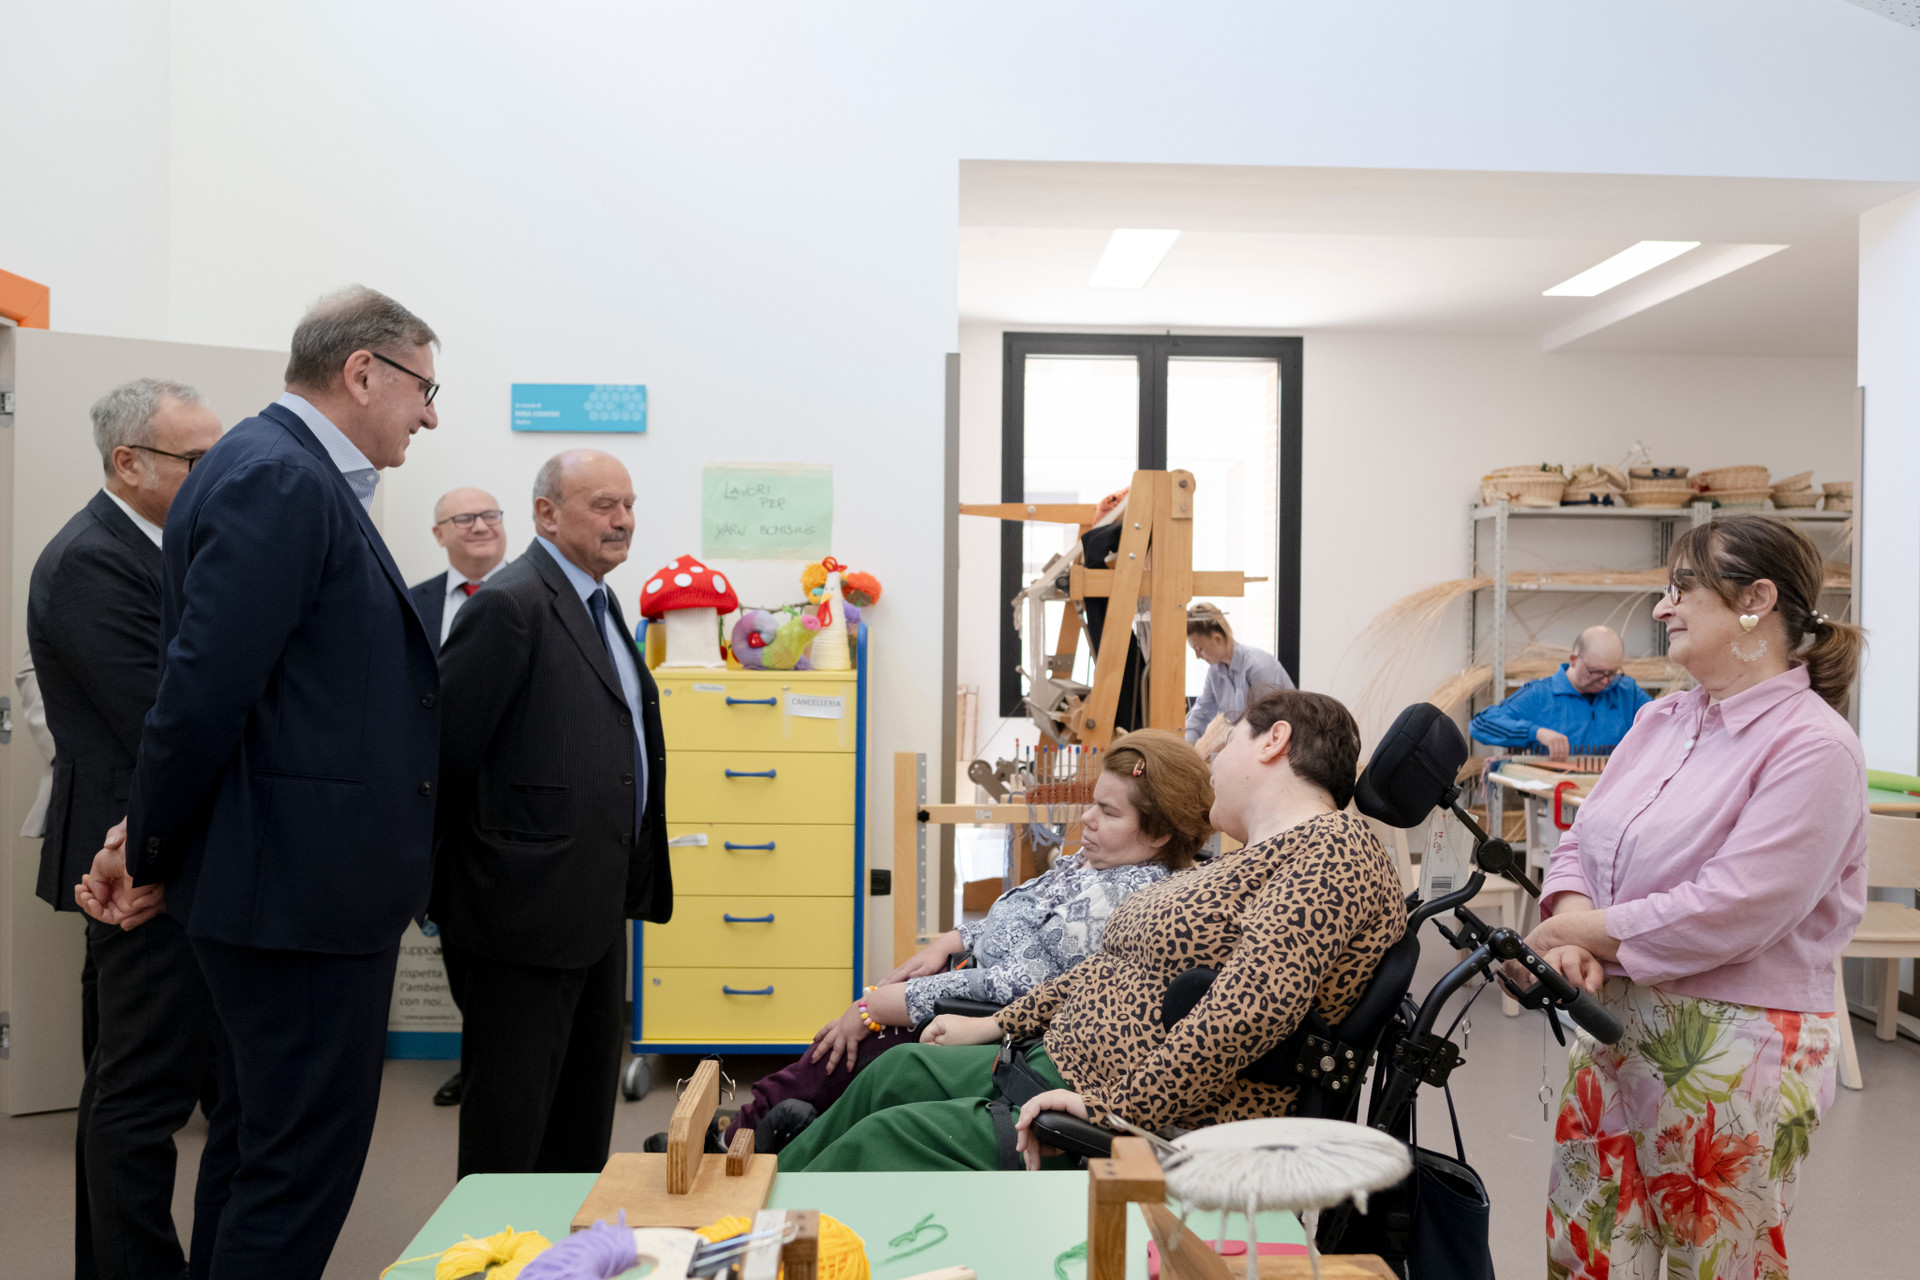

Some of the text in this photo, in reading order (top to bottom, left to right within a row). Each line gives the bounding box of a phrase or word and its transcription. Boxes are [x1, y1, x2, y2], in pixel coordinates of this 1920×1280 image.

[724, 480, 770, 499] LAVORI
[759, 497, 785, 511] PER
[715, 523, 746, 540] YARN
[791, 697, 841, 708] CANCELLERIA
[400, 969, 442, 979] rispetta
[400, 981, 449, 992] l'ambien
[399, 998, 420, 1007] con
